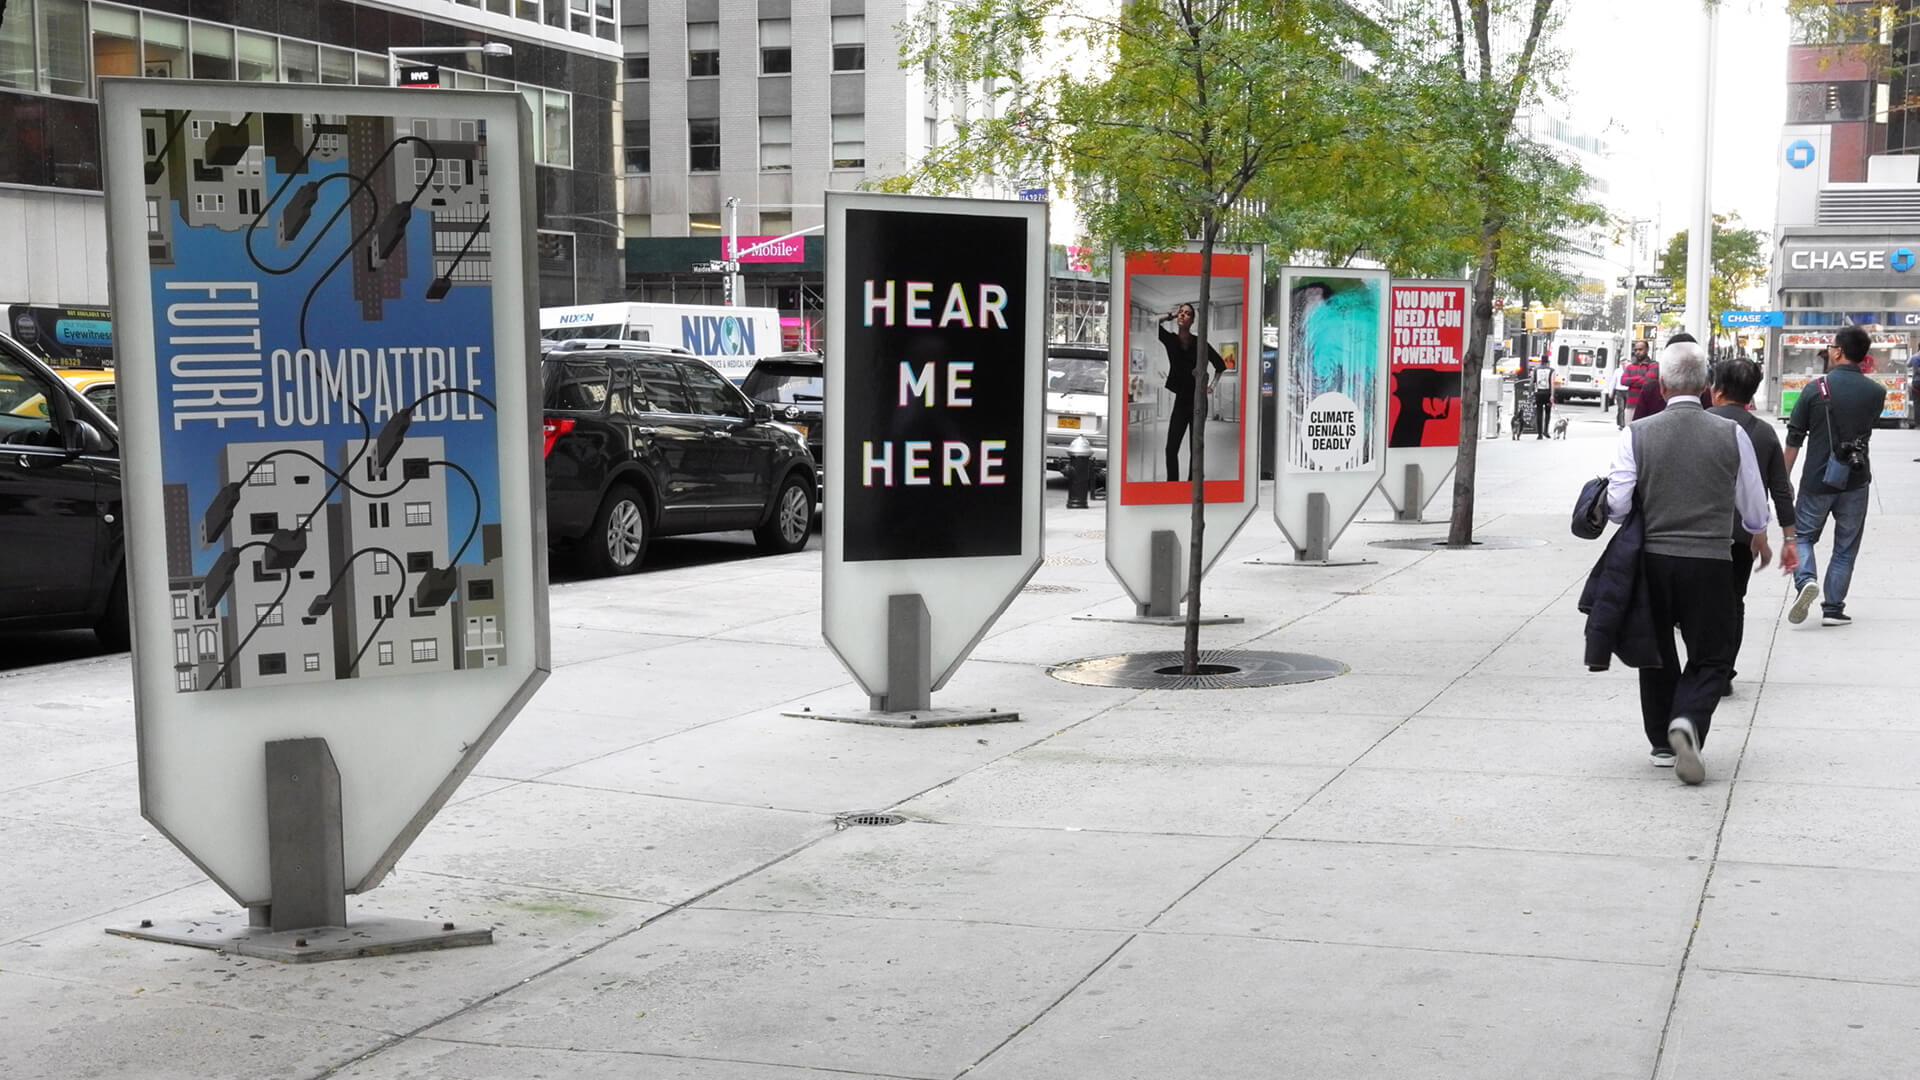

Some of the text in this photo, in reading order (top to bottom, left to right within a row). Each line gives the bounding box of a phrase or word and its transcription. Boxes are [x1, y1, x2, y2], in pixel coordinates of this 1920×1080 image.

[410, 71, 429, 81] NYC
[1791, 250, 1886, 270] CHASE
[863, 280, 1009, 329] HEAR
[1395, 290, 1457, 309] YOU DON'T
[1394, 309, 1462, 328] NEED A GUN
[1727, 314, 1762, 323] CHASE
[681, 315, 756, 356] NIXON
[1394, 328, 1441, 346] TO FEEL
[165, 281, 265, 431] FUTURE
[1392, 346, 1460, 365] POWERFUL.
[271, 347, 484, 427] COMPATIBLE
[898, 361, 974, 407] ME
[1310, 411, 1354, 424] CLIMATE
[1308, 424, 1356, 437] DENIAL IS
[1312, 438, 1351, 450] DEADLY
[862, 440, 1006, 487] HERE
